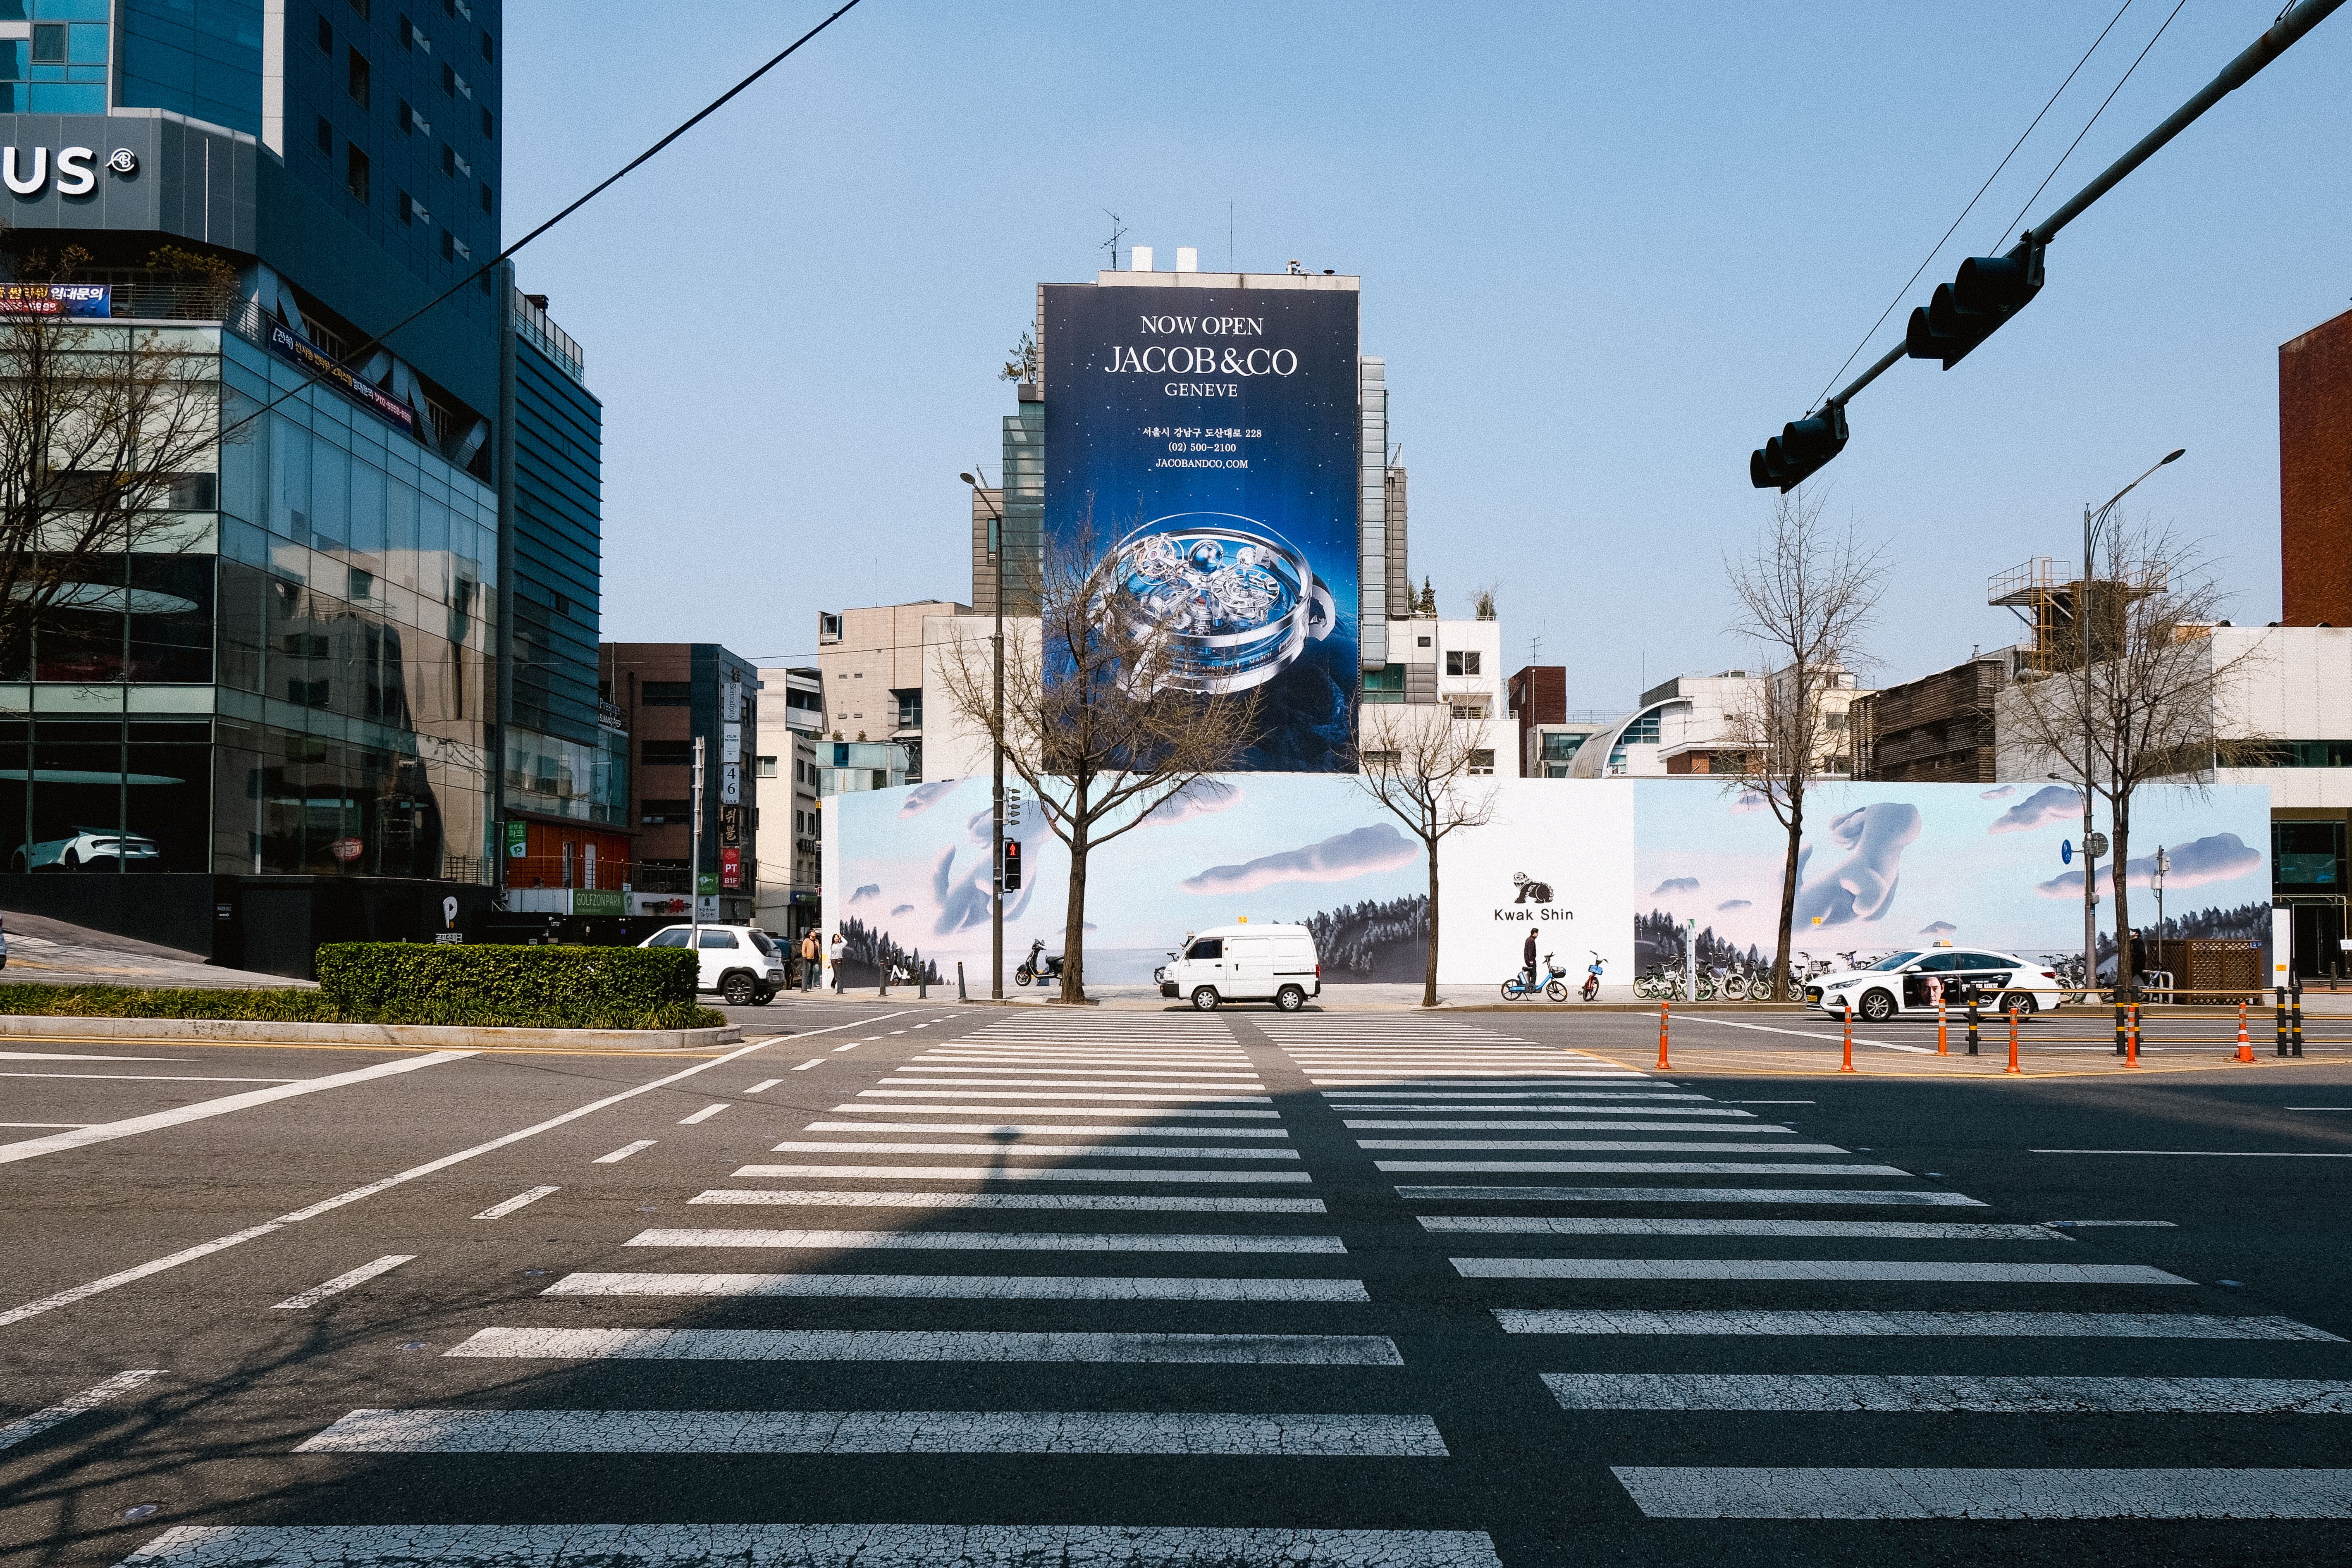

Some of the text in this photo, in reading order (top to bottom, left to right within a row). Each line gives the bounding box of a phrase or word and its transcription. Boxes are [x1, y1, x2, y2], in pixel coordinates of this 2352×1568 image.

[51, 287, 104, 301] 임대문의
[1141, 315, 1263, 336] NOW OPEN
[1104, 346, 1298, 376] JACOB&CO
[1165, 383, 1238, 397] GENEVE
[1142, 427, 1262, 438] 서울시 강남구 도산대로 228
[1168, 442, 1236, 453] (02) 500-2100
[1156, 459, 1248, 469] JACOBANDCO.COM
[1249, 652, 1272, 664] MARCH
[599, 697, 621, 717] Prestige
[728, 683, 736, 720] Serendipity
[725, 864, 738, 873] PT
[1494, 908, 1573, 921] Kwak Shin
